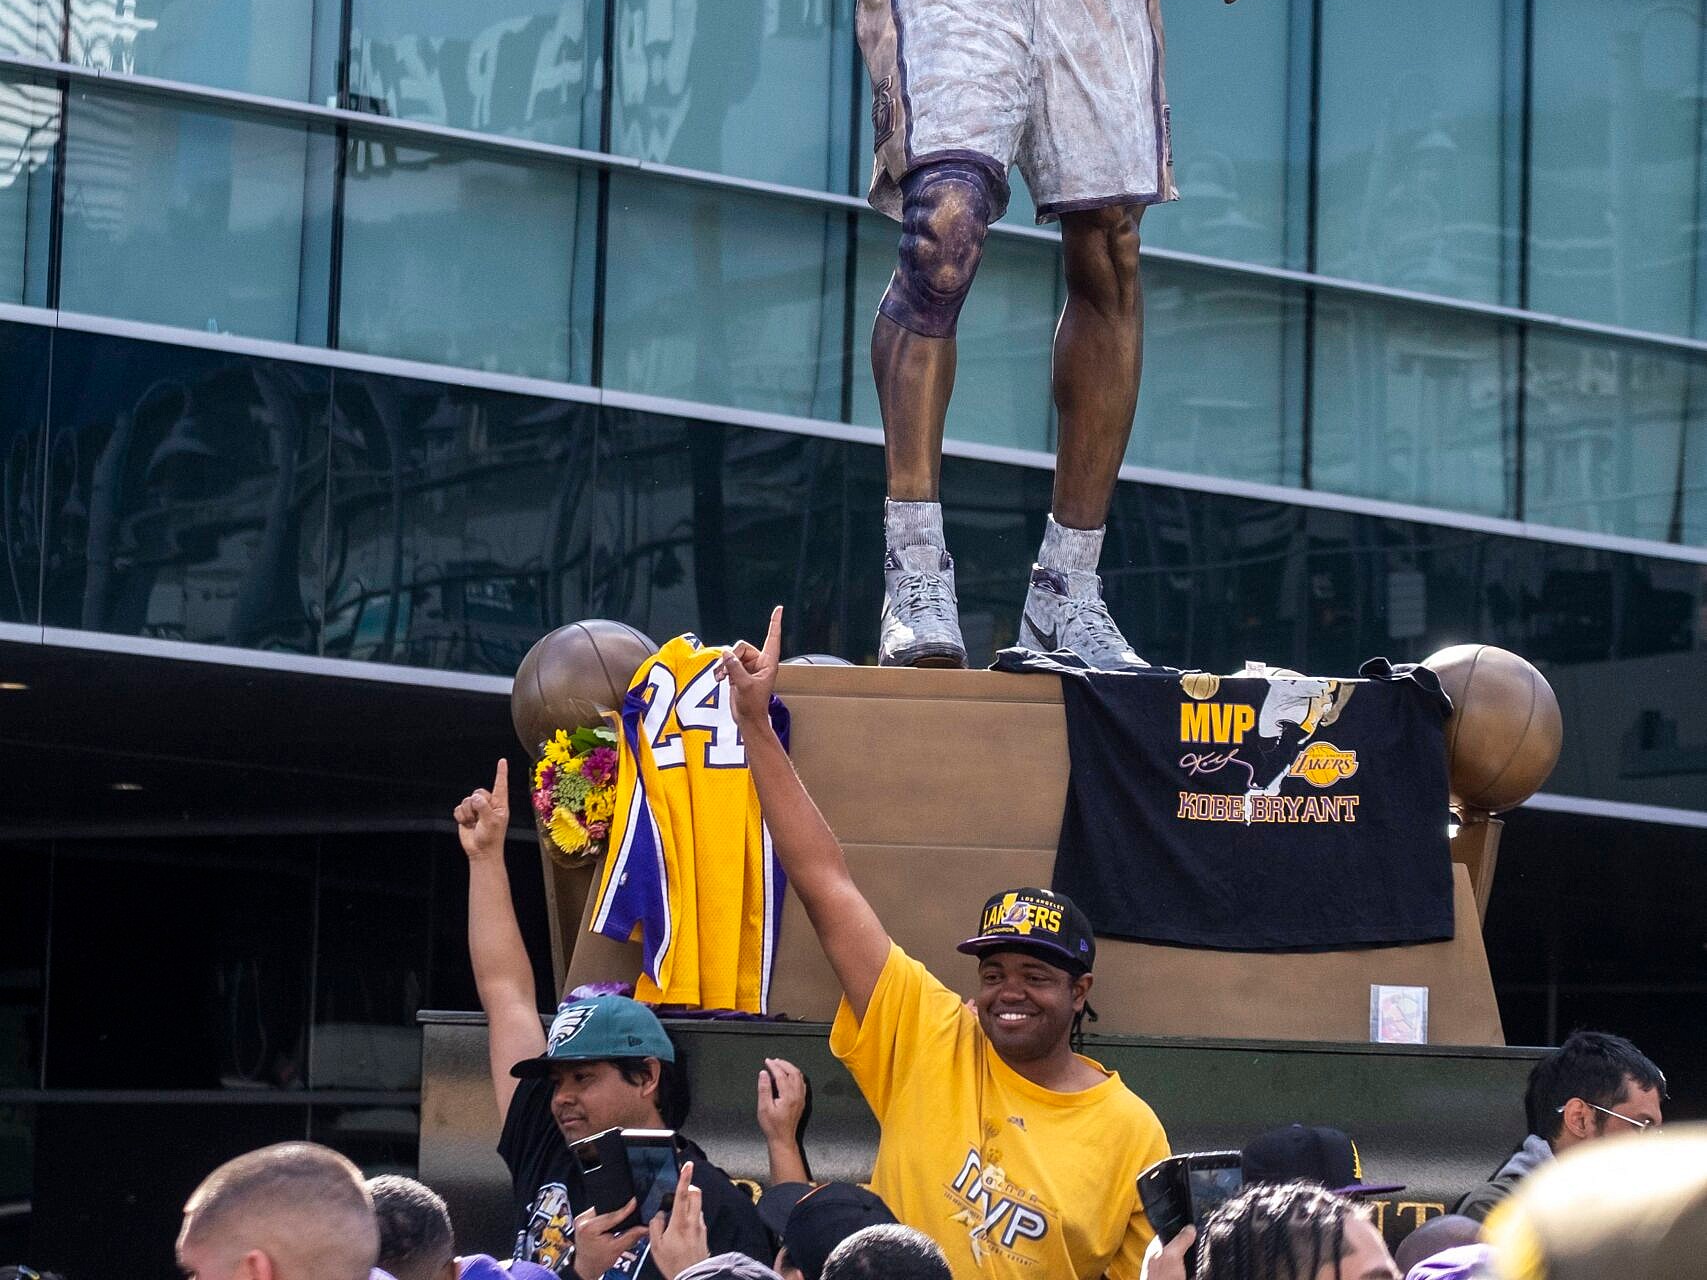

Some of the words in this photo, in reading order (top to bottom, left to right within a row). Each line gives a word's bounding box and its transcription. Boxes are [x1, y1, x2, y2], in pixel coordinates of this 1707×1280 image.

[641, 661, 748, 770] 24
[1180, 703, 1256, 744] MVP
[1290, 754, 1358, 776] LAKERS
[1177, 791, 1245, 822] KOBE
[1250, 795, 1360, 823] BRYANT
